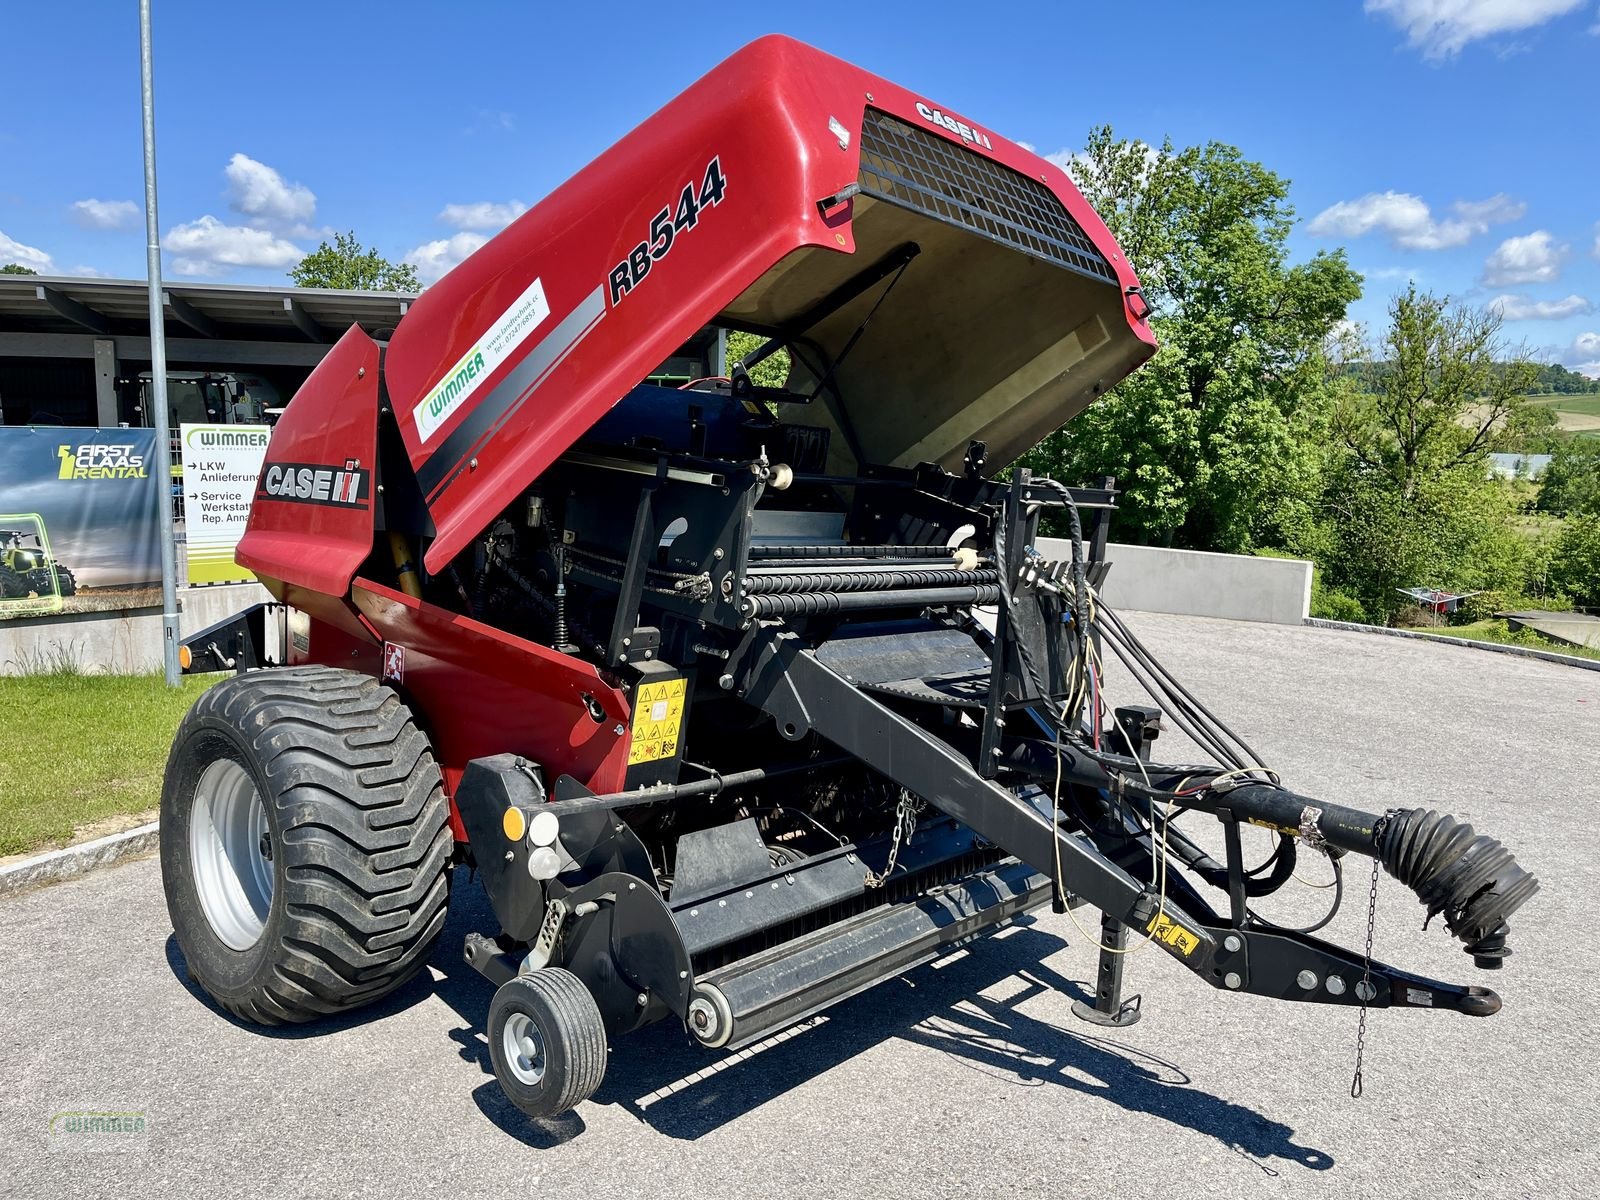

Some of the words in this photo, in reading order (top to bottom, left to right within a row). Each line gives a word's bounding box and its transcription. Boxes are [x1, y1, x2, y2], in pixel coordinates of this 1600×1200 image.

[915, 102, 974, 142] CASE
[608, 154, 728, 308] RB544
[485, 294, 539, 351] www.landtechnik.cc
[504, 309, 536, 344] 07247/6853
[429, 352, 485, 418] WIMMER
[200, 433, 267, 446] WIMMER
[77, 445, 135, 457] FIRST
[75, 456, 144, 468] CLAAS
[199, 462, 225, 471] LKW
[73, 467, 148, 479] RENTAL
[265, 465, 332, 500] CASE
[200, 492, 241, 501] Service
[202, 515, 223, 524] Rep.
